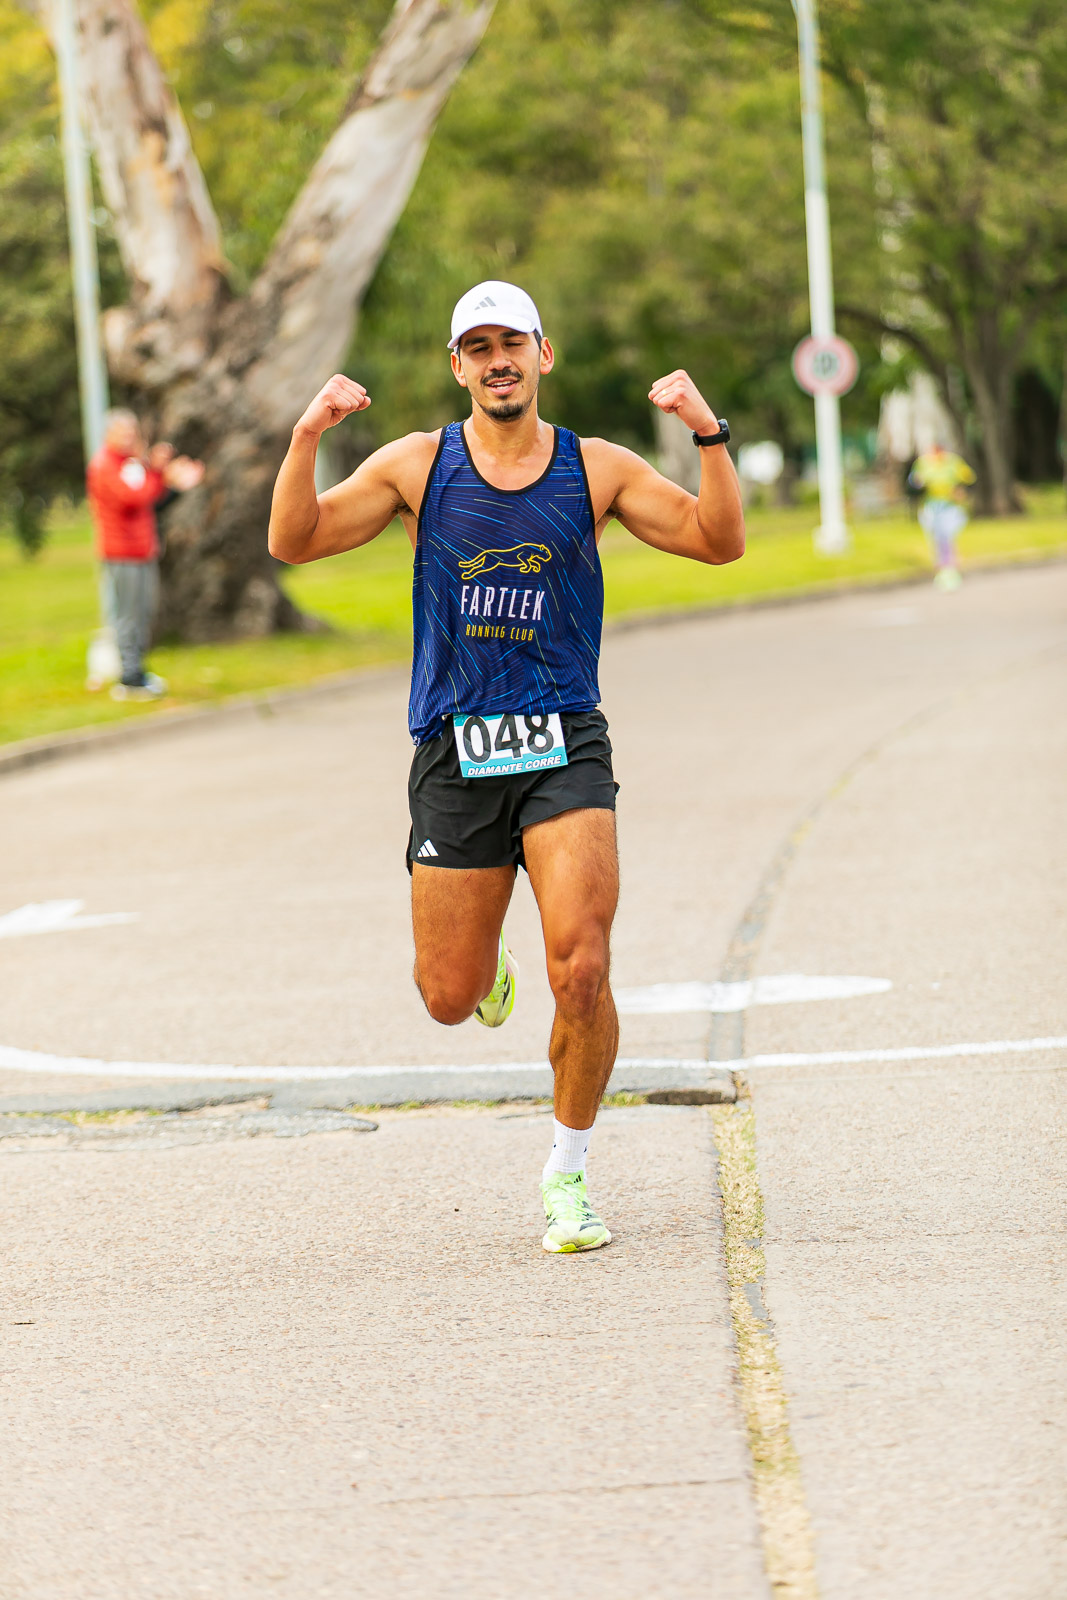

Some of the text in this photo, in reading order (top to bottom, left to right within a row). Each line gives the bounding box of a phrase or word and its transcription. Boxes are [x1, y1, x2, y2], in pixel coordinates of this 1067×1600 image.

[461, 585, 545, 620] FARTLEK
[466, 624, 534, 641] RUNNING CLUB
[463, 713, 554, 763] 048
[467, 755, 562, 776] DIAMANTE CORRE
